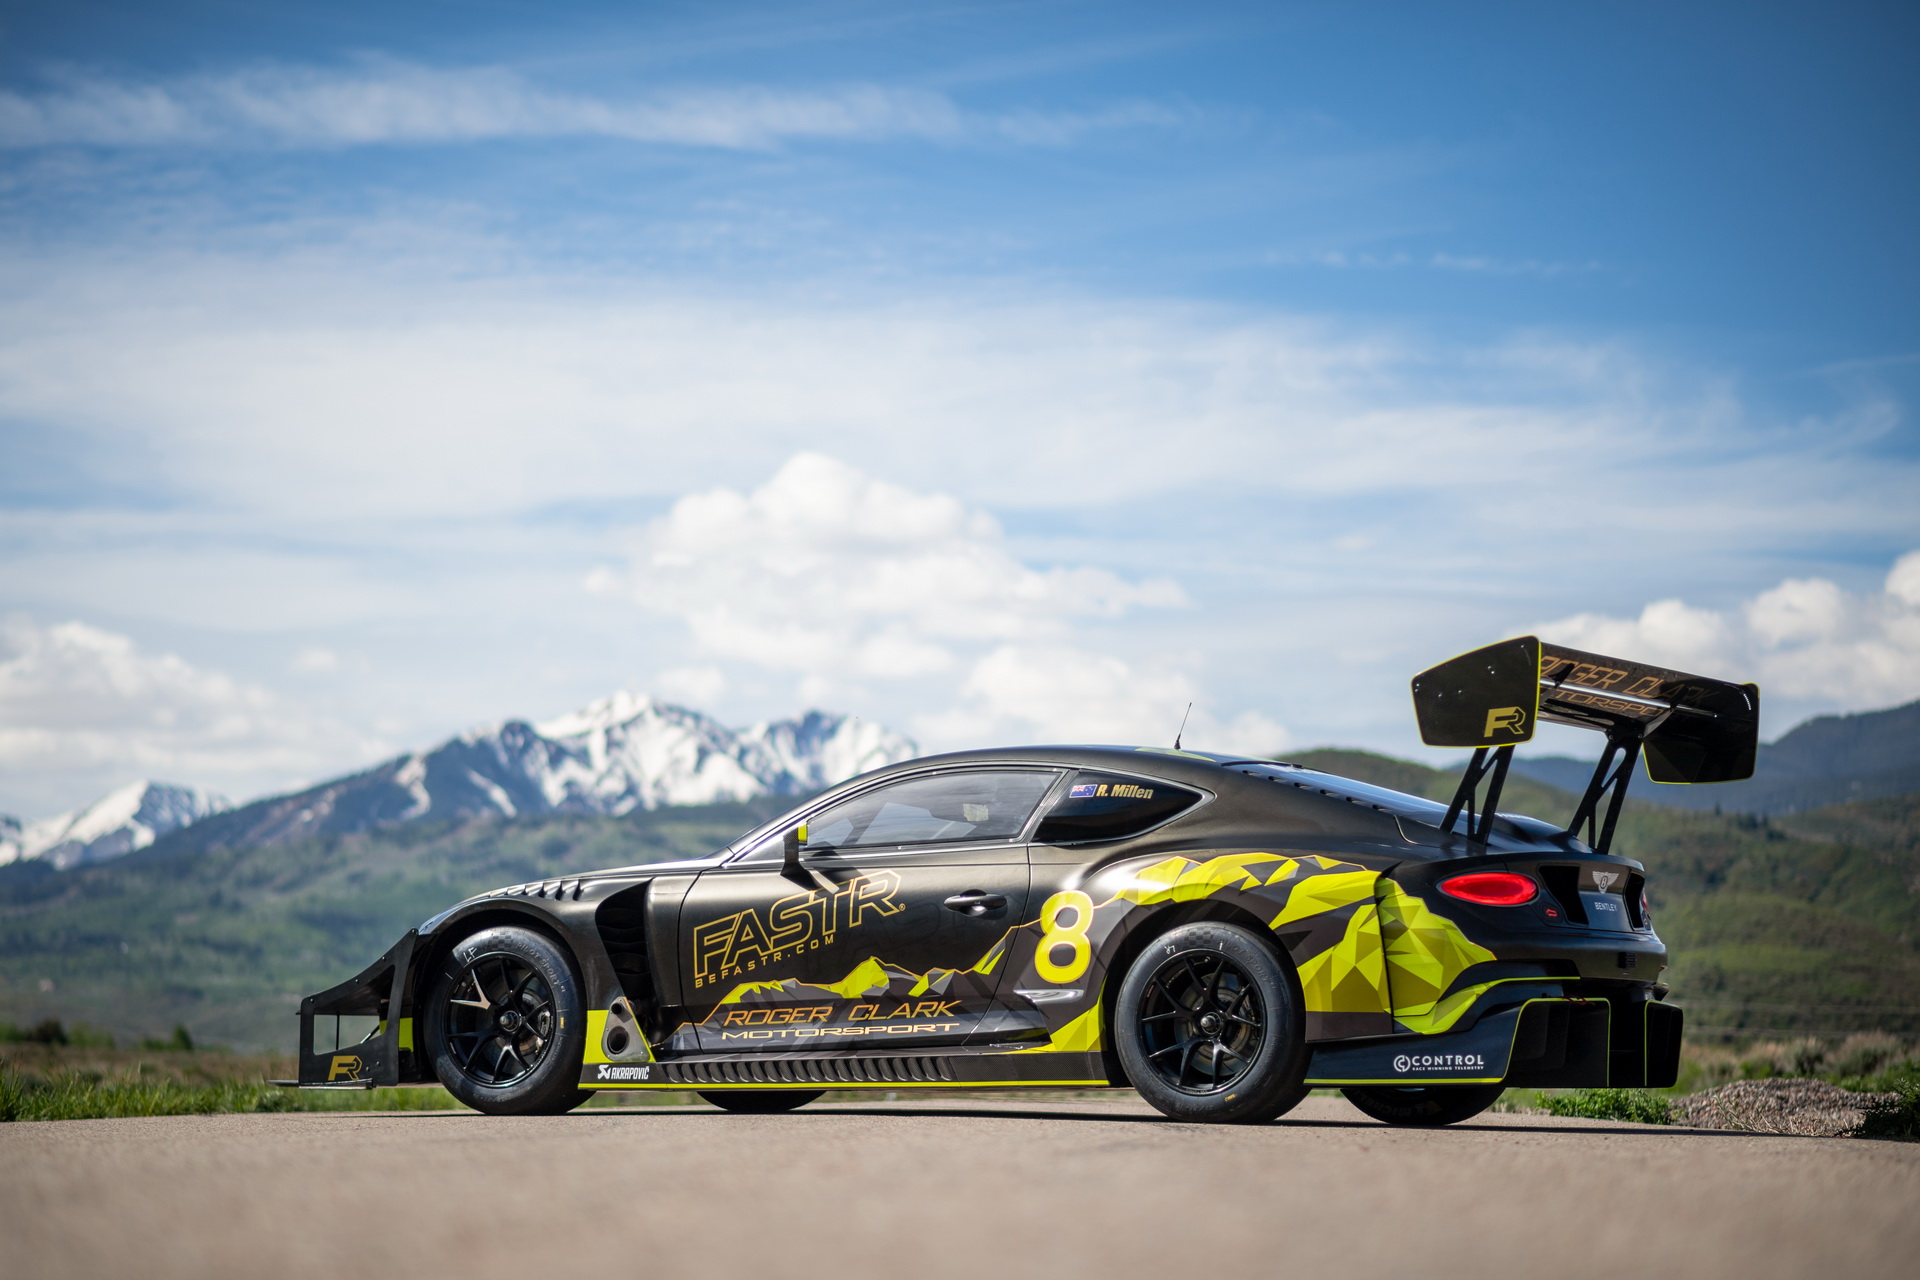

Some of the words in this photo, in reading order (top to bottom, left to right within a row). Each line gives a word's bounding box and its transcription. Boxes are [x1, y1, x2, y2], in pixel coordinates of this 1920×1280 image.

[1096, 784, 1108, 797] R.
[1110, 784, 1154, 799] Millen
[1594, 902, 1618, 912] BENTLEY
[1034, 890, 1094, 984] 8
[463, 946, 478, 963] LF
[695, 934, 835, 989] BEFASTR.COM
[516, 942, 542, 959] PILOT
[540, 958, 561, 985] SPORT
[723, 1006, 834, 1026] ROGER
[848, 1000, 962, 1022] CLARK
[722, 1023, 960, 1040] MOTORSPORT
[1412, 1054, 1484, 1066] CONTROL
